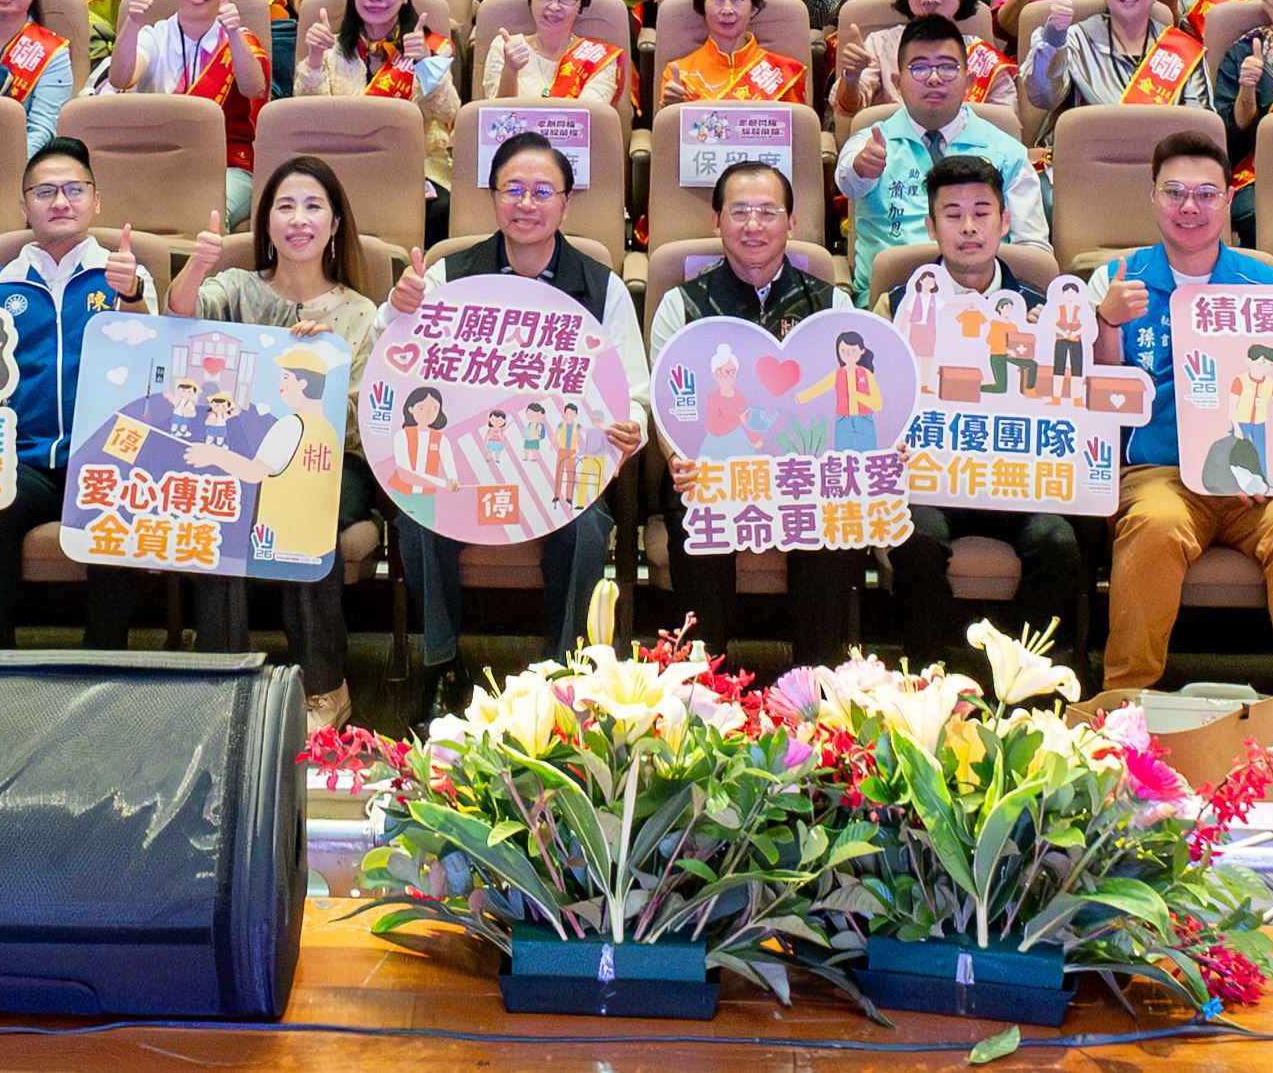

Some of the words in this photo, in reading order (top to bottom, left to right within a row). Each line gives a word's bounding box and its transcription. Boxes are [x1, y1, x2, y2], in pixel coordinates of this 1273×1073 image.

[414, 301, 583, 352] 志願閃耀
[423, 343, 590, 394] 綻放榮耀
[1193, 383, 1217, 393] 26
[372, 411, 391, 422] 26
[676, 397, 696, 407] 26
[108, 427, 142, 454] 停
[905, 410, 1076, 458] 績優團隊
[81, 469, 238, 518] 愛心傳遞
[686, 453, 905, 503] 志願奉獻愛
[908, 452, 1074, 501] 合作無間
[1090, 469, 1112, 480] 26
[482, 491, 514, 518] 停
[688, 499, 909, 549] 生命更精彩
[88, 514, 216, 565] 金質獎
[256, 549, 272, 558] 26
